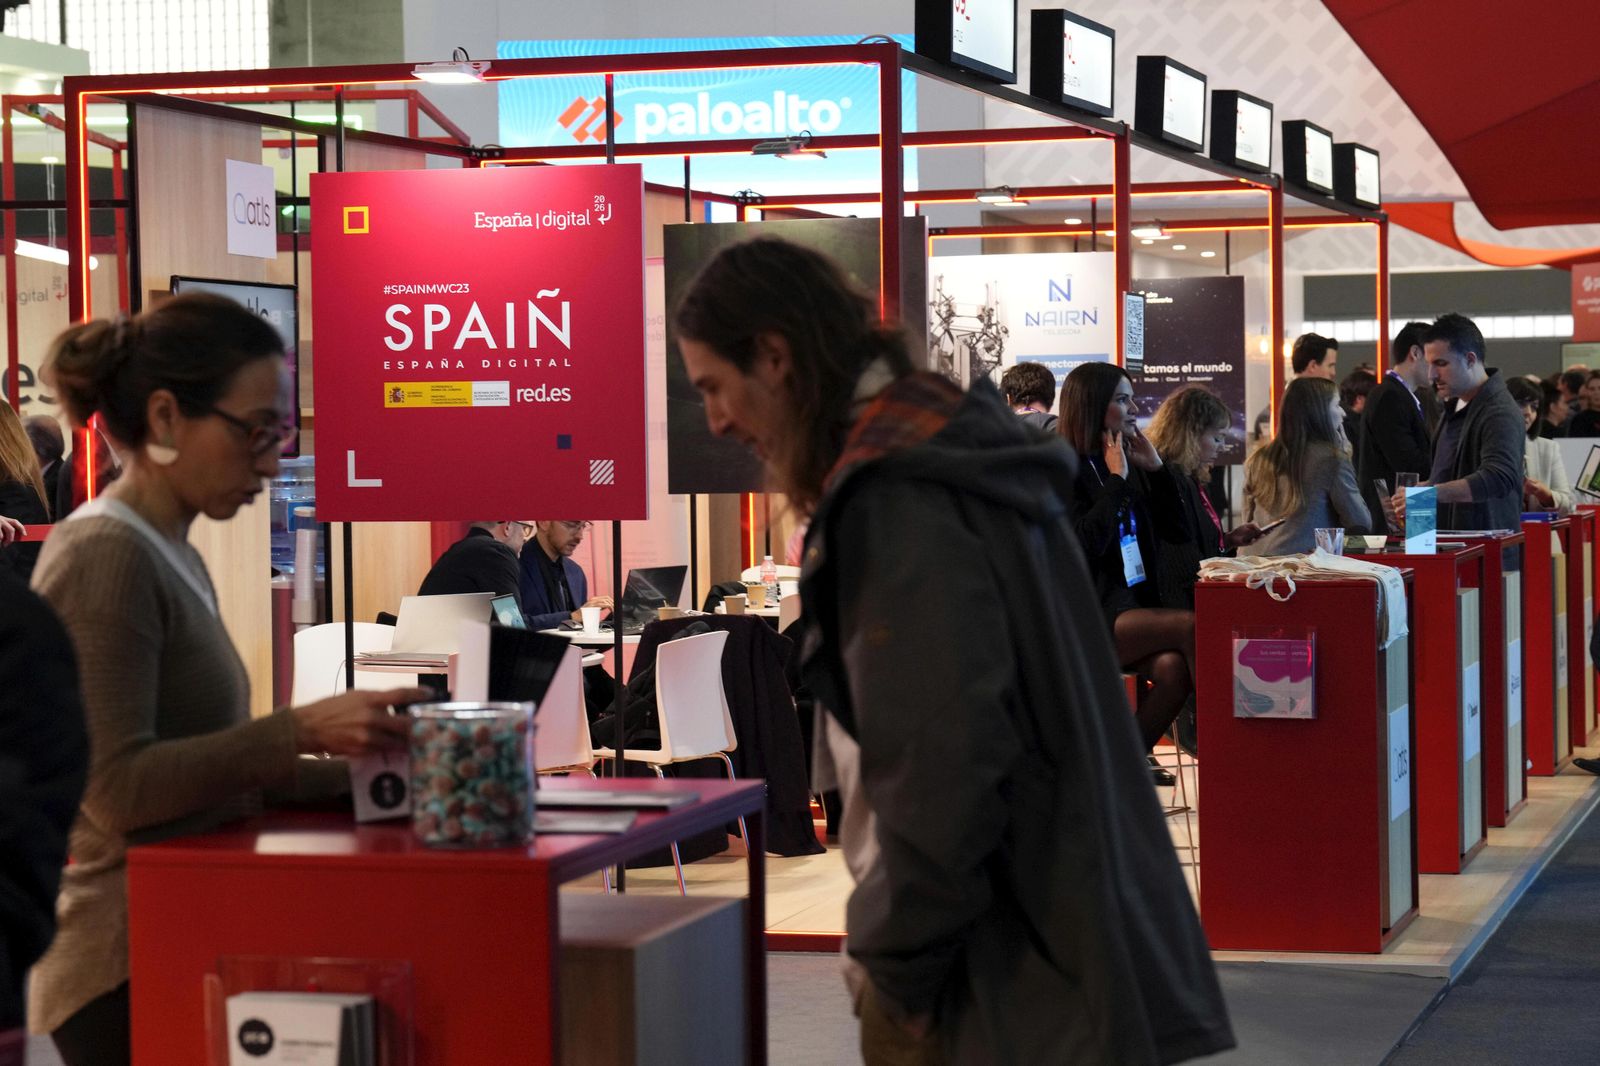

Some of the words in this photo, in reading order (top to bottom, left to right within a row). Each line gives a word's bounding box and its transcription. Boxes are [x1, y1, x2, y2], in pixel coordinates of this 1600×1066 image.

[635, 90, 842, 143] paloalto
[474, 212, 533, 232] España
[542, 209, 591, 231] digital
[383, 283, 470, 295] #SPAINMWC23
[383, 288, 571, 352] SPAIÑ
[383, 358, 466, 370] ESPAÑA
[482, 359, 572, 368] DIGITAL
[1181, 362, 1191, 373] el
[1194, 362, 1232, 373] mundo
[516, 384, 572, 403] red.es
